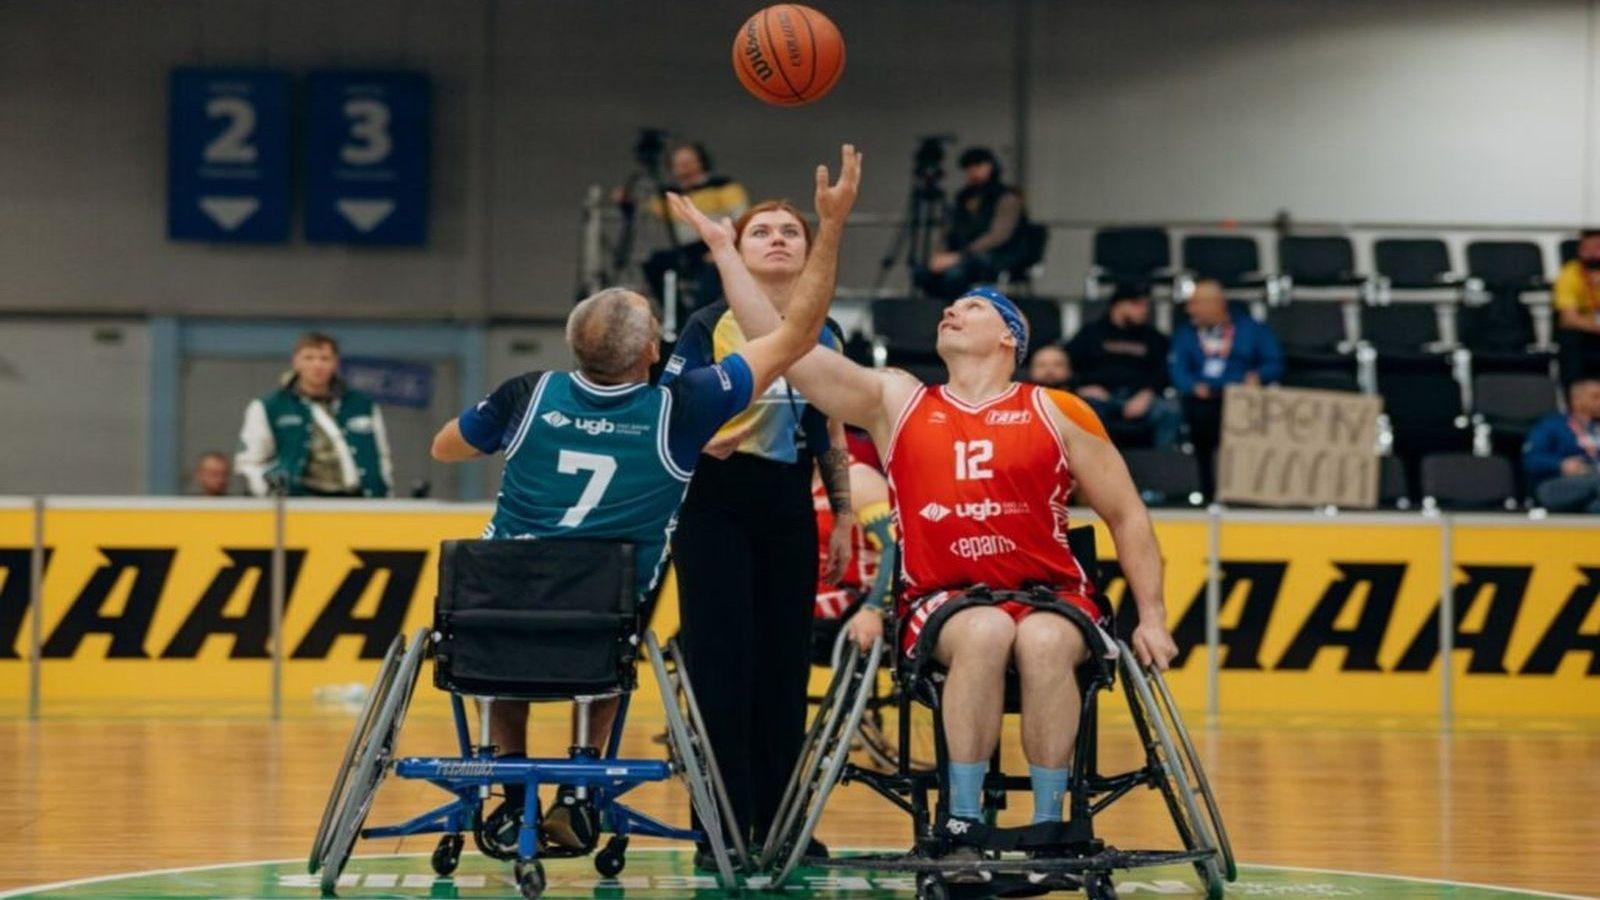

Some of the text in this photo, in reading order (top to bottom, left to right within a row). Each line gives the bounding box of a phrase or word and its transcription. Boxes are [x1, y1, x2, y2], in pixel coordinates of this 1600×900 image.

[204, 98, 258, 163] 2
[341, 99, 392, 165] 3
[575, 417, 615, 436] ugb
[954, 439, 994, 480] 12
[556, 449, 618, 528] 7
[954, 498, 1001, 521] ugb
